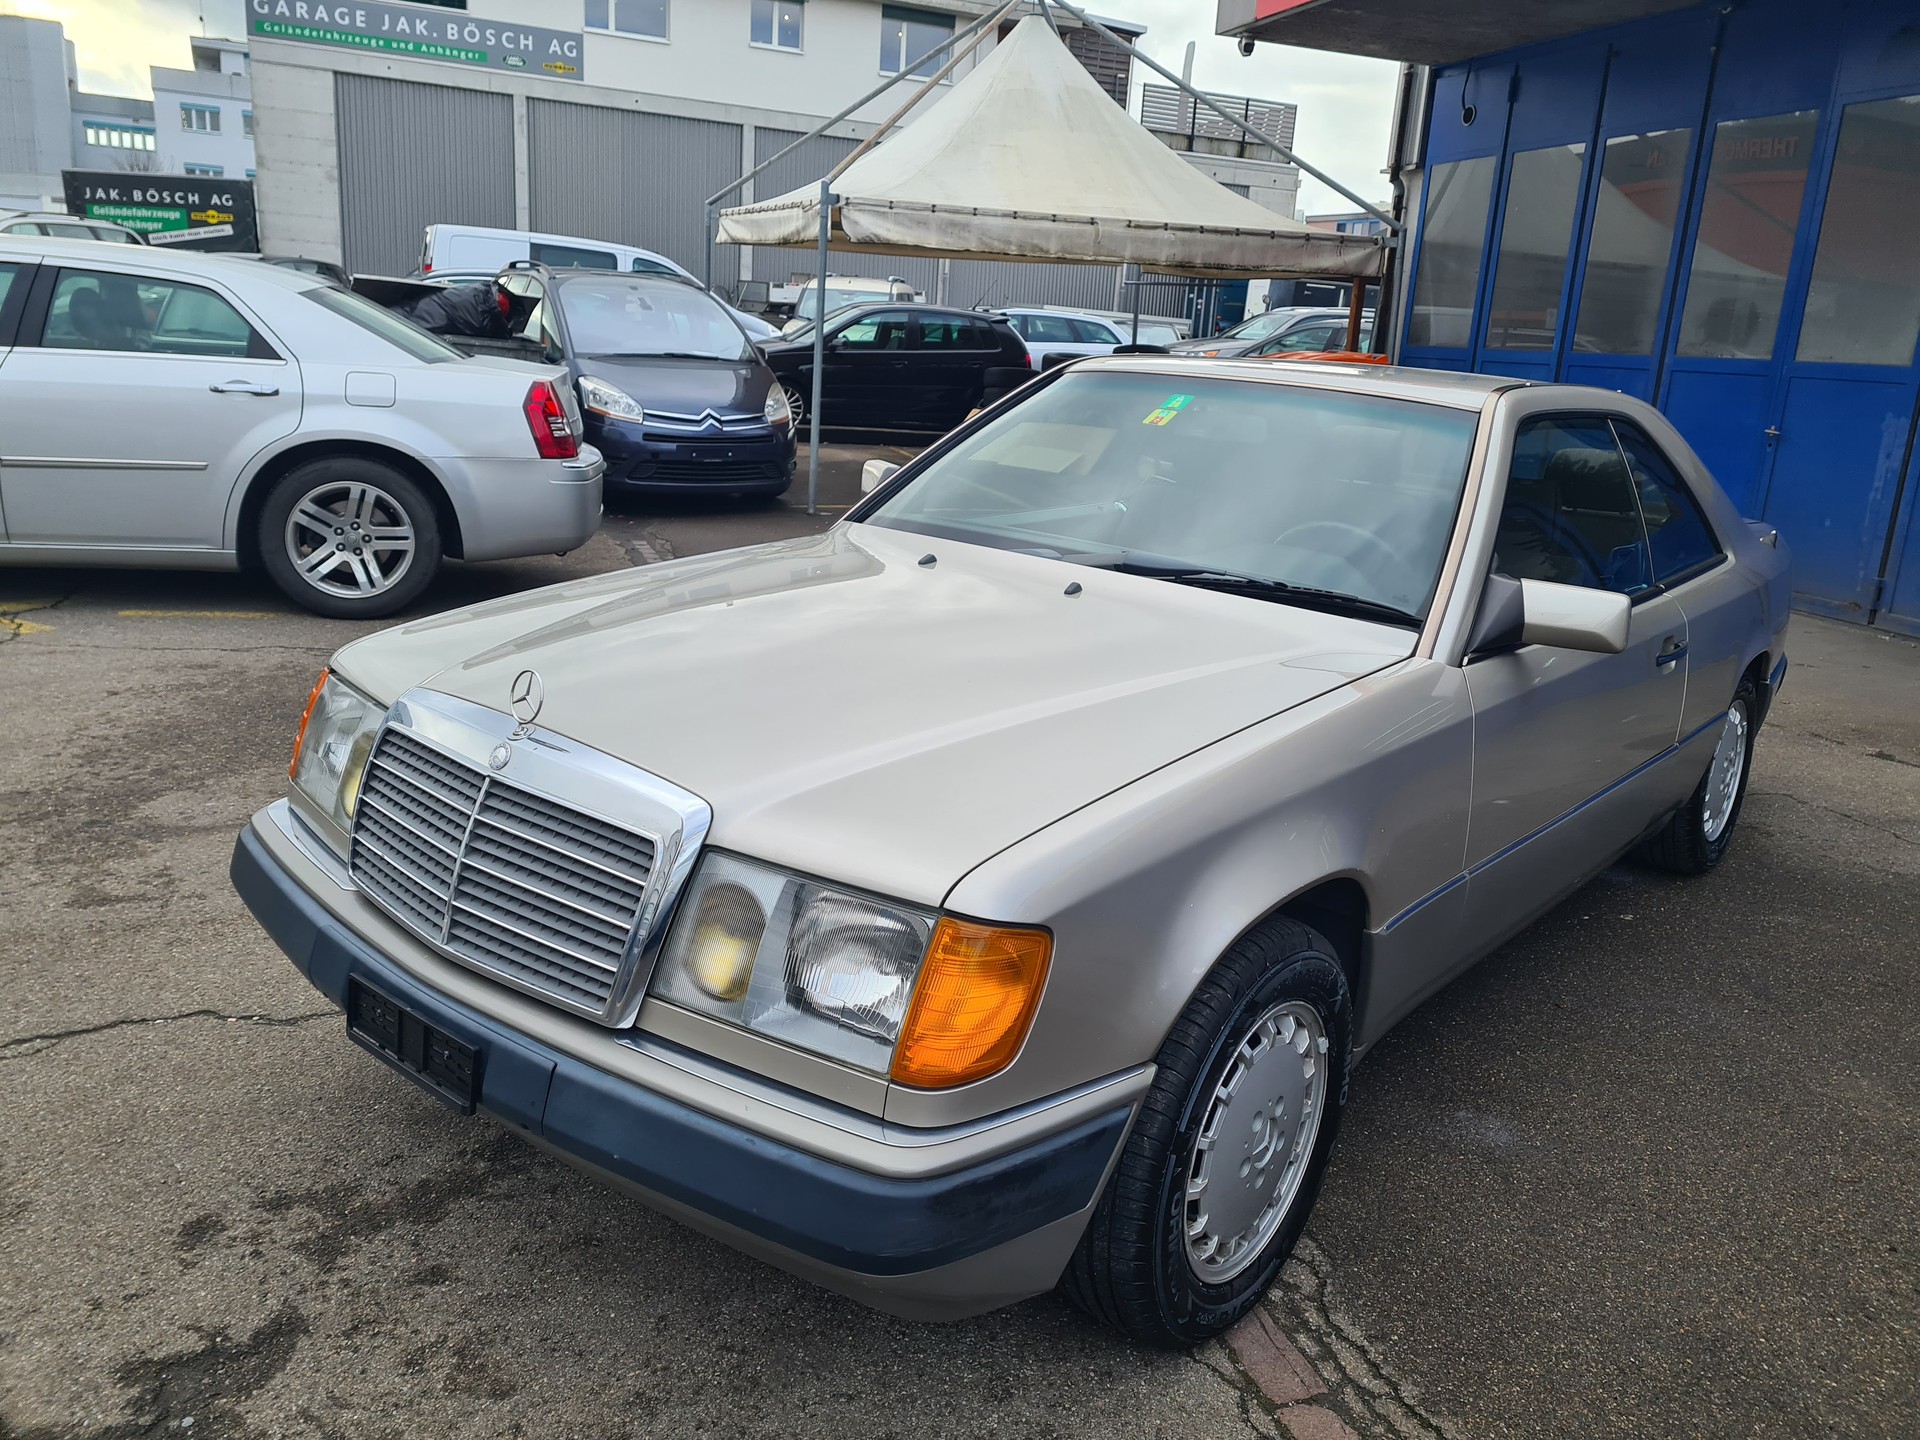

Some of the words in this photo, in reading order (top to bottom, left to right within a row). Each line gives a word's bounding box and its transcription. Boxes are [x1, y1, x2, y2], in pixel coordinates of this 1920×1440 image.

[253, 0, 366, 28] GARAGE
[381, 13, 438, 38] JAK.
[446, 22, 533, 51] BÖSCH
[548, 38, 577, 57] AG
[263, 21, 385, 48] Geländefahrzeuge
[391, 40, 414, 51] und
[420, 43, 480, 60] Anhänger
[84, 187, 126, 201] JAK.
[133, 188, 199, 204] BÖSCH
[210, 194, 233, 206] AG
[93, 205, 180, 220] Geländefahrzeuge
